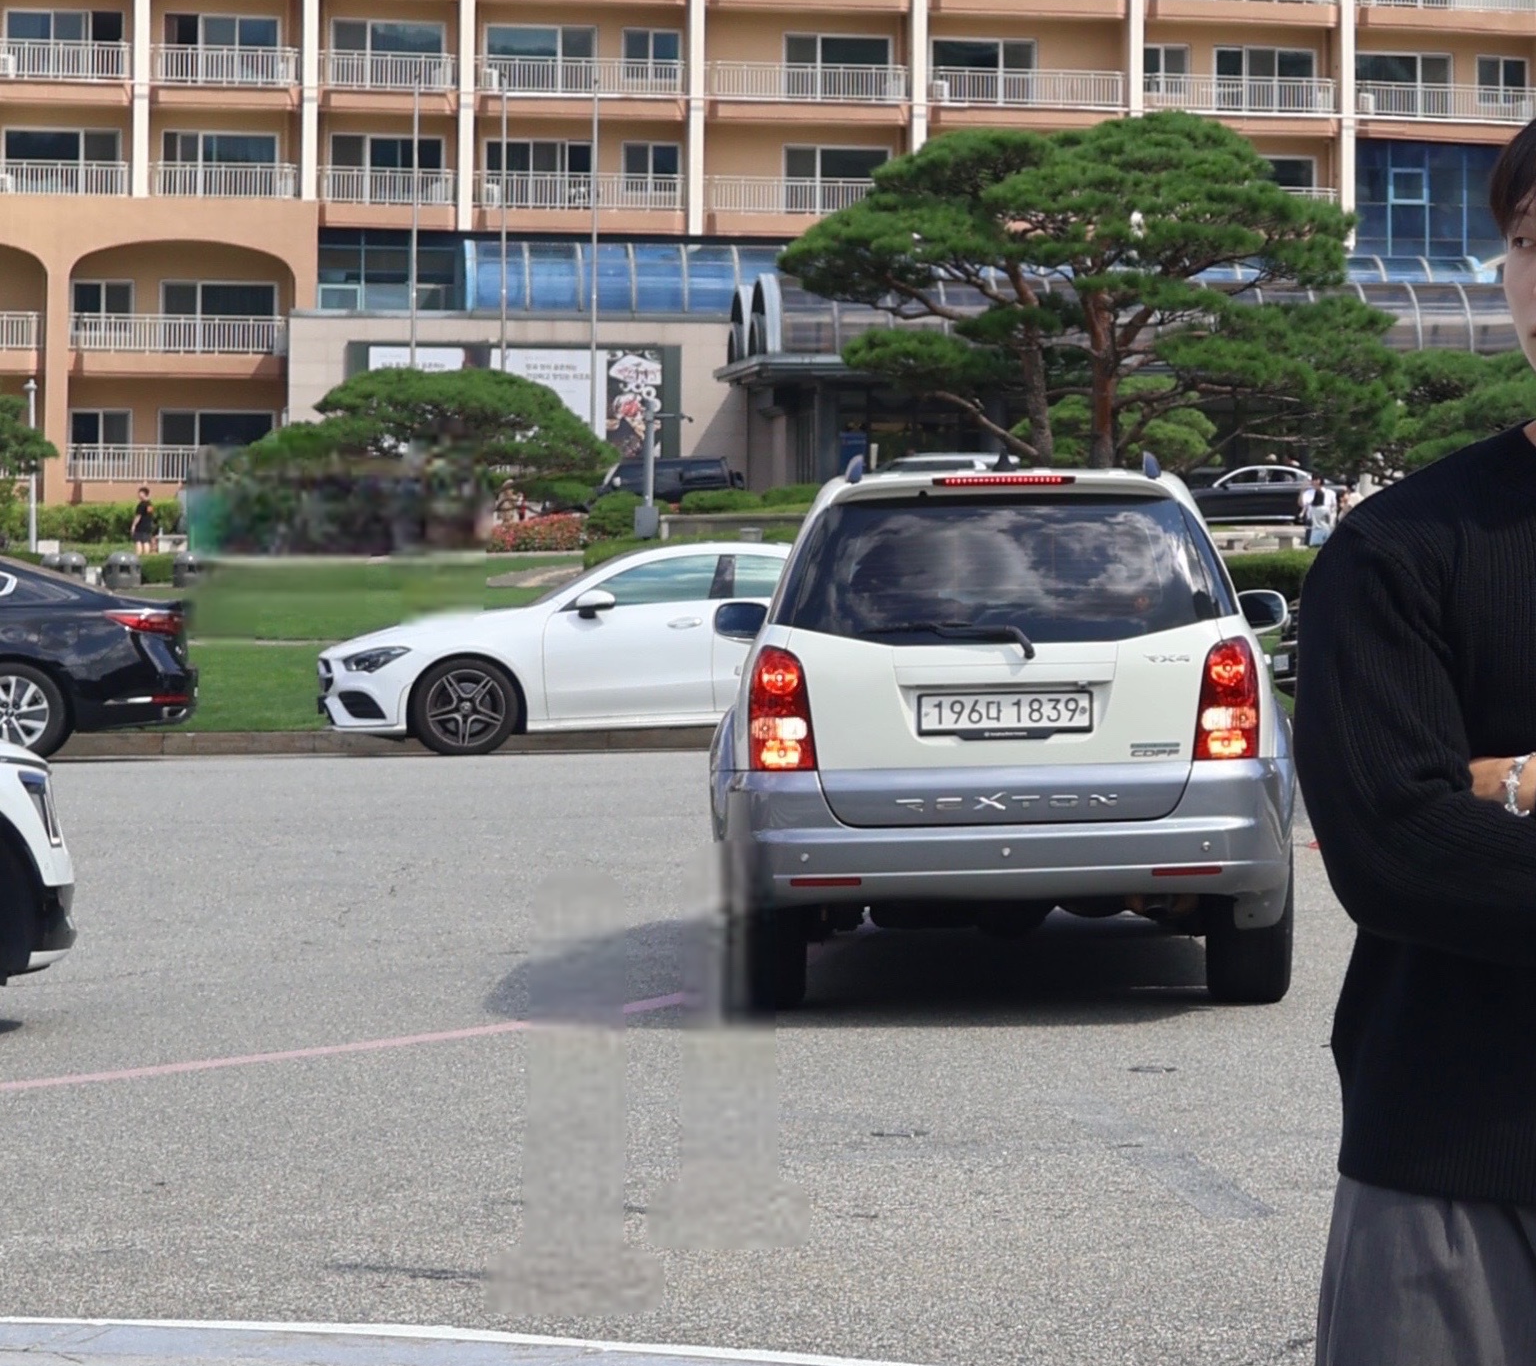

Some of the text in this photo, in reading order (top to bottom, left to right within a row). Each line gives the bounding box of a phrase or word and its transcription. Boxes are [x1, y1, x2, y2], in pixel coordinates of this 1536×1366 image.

[933, 697, 1080, 725] 196다 1839
[895, 791, 1118, 813] REXTON
